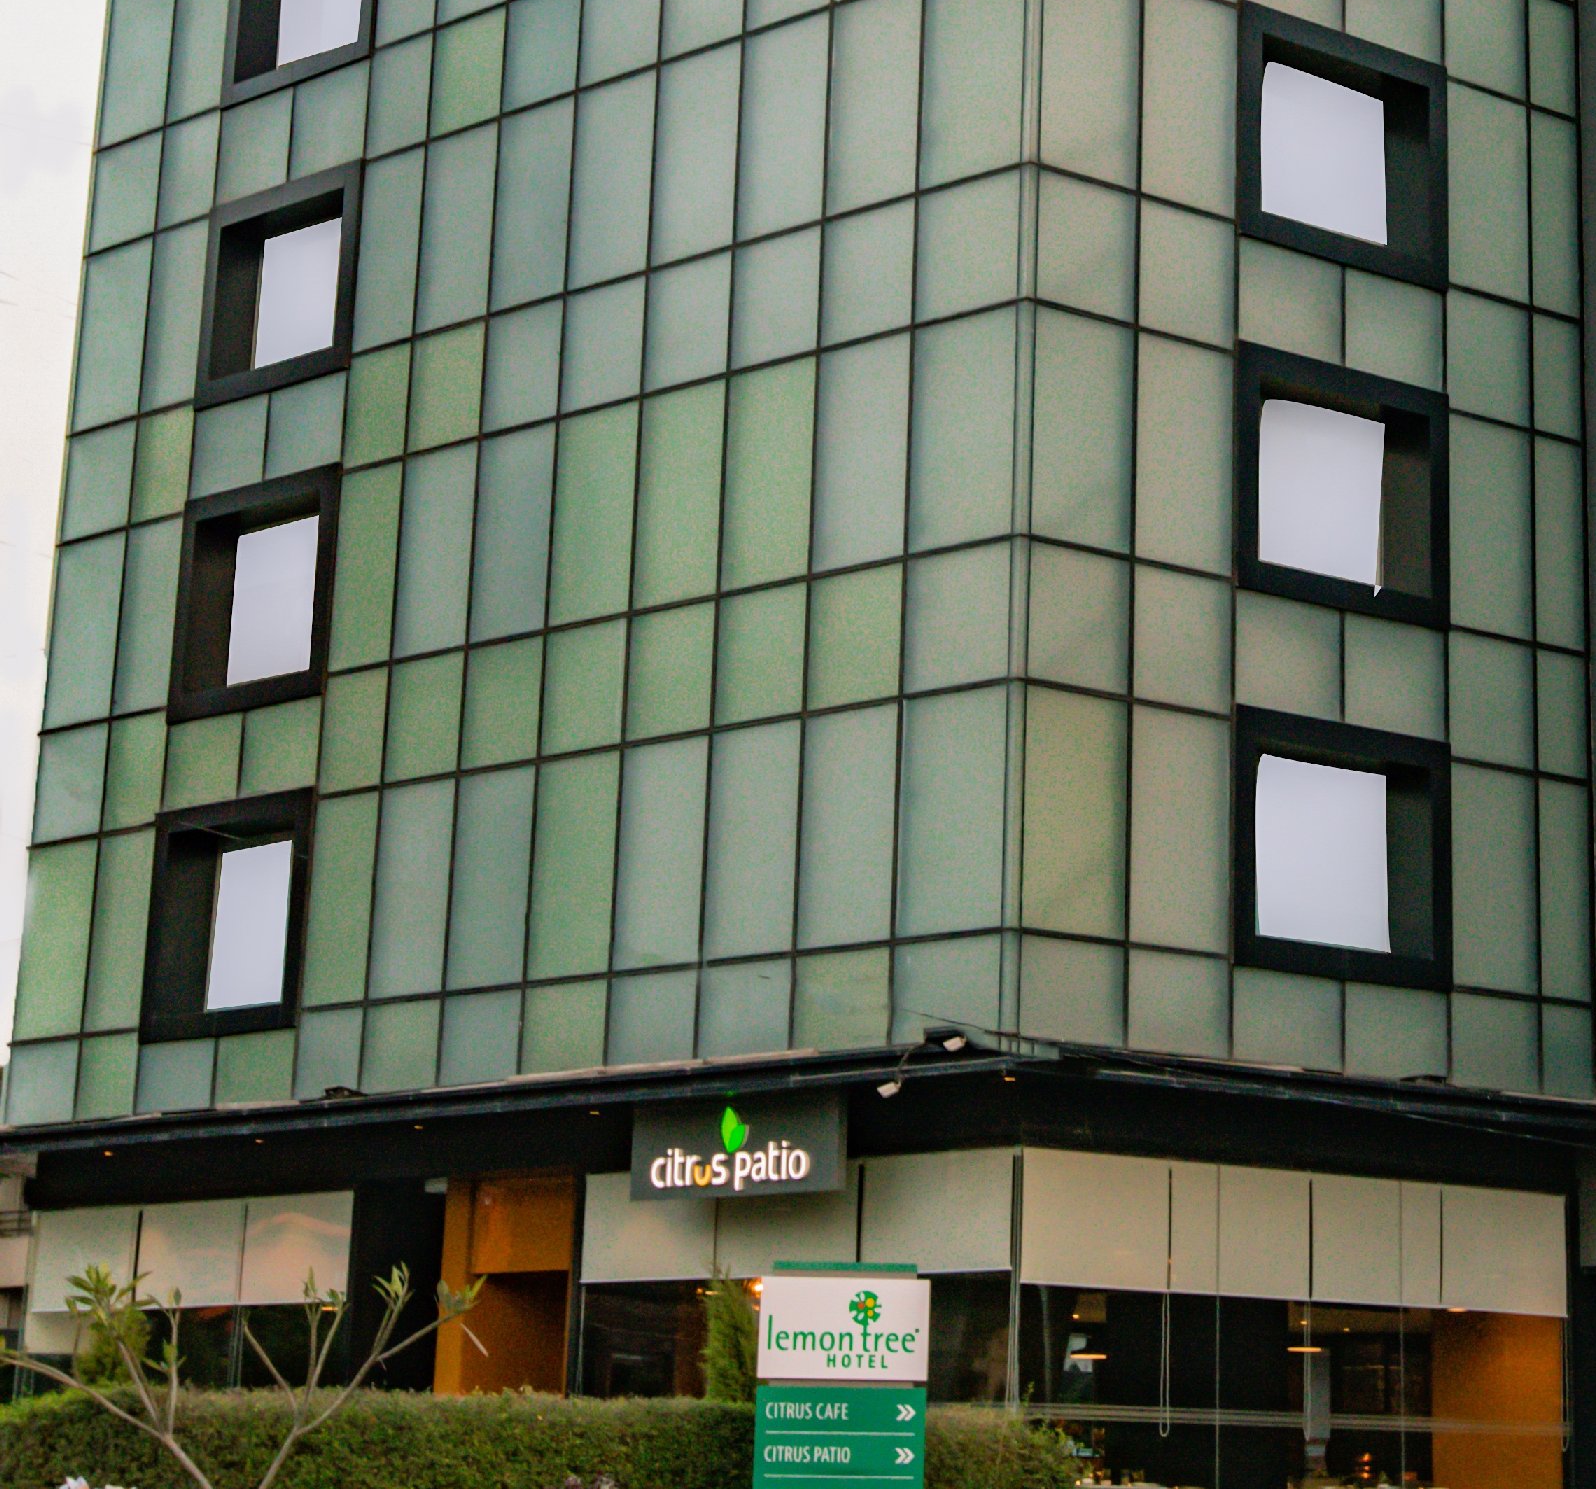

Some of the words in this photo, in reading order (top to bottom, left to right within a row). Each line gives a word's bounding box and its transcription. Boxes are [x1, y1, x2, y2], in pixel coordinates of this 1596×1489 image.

[650, 1147, 729, 1189] citrus
[734, 1140, 810, 1192] patio
[767, 1314, 854, 1351] lemon
[860, 1324, 916, 1353] tree
[826, 1353, 889, 1369] HOTEL
[765, 1402, 813, 1420] CITRUS
[816, 1402, 849, 1421] CAFE
[763, 1444, 811, 1463] CITRUS
[813, 1445, 851, 1464] PATIO
